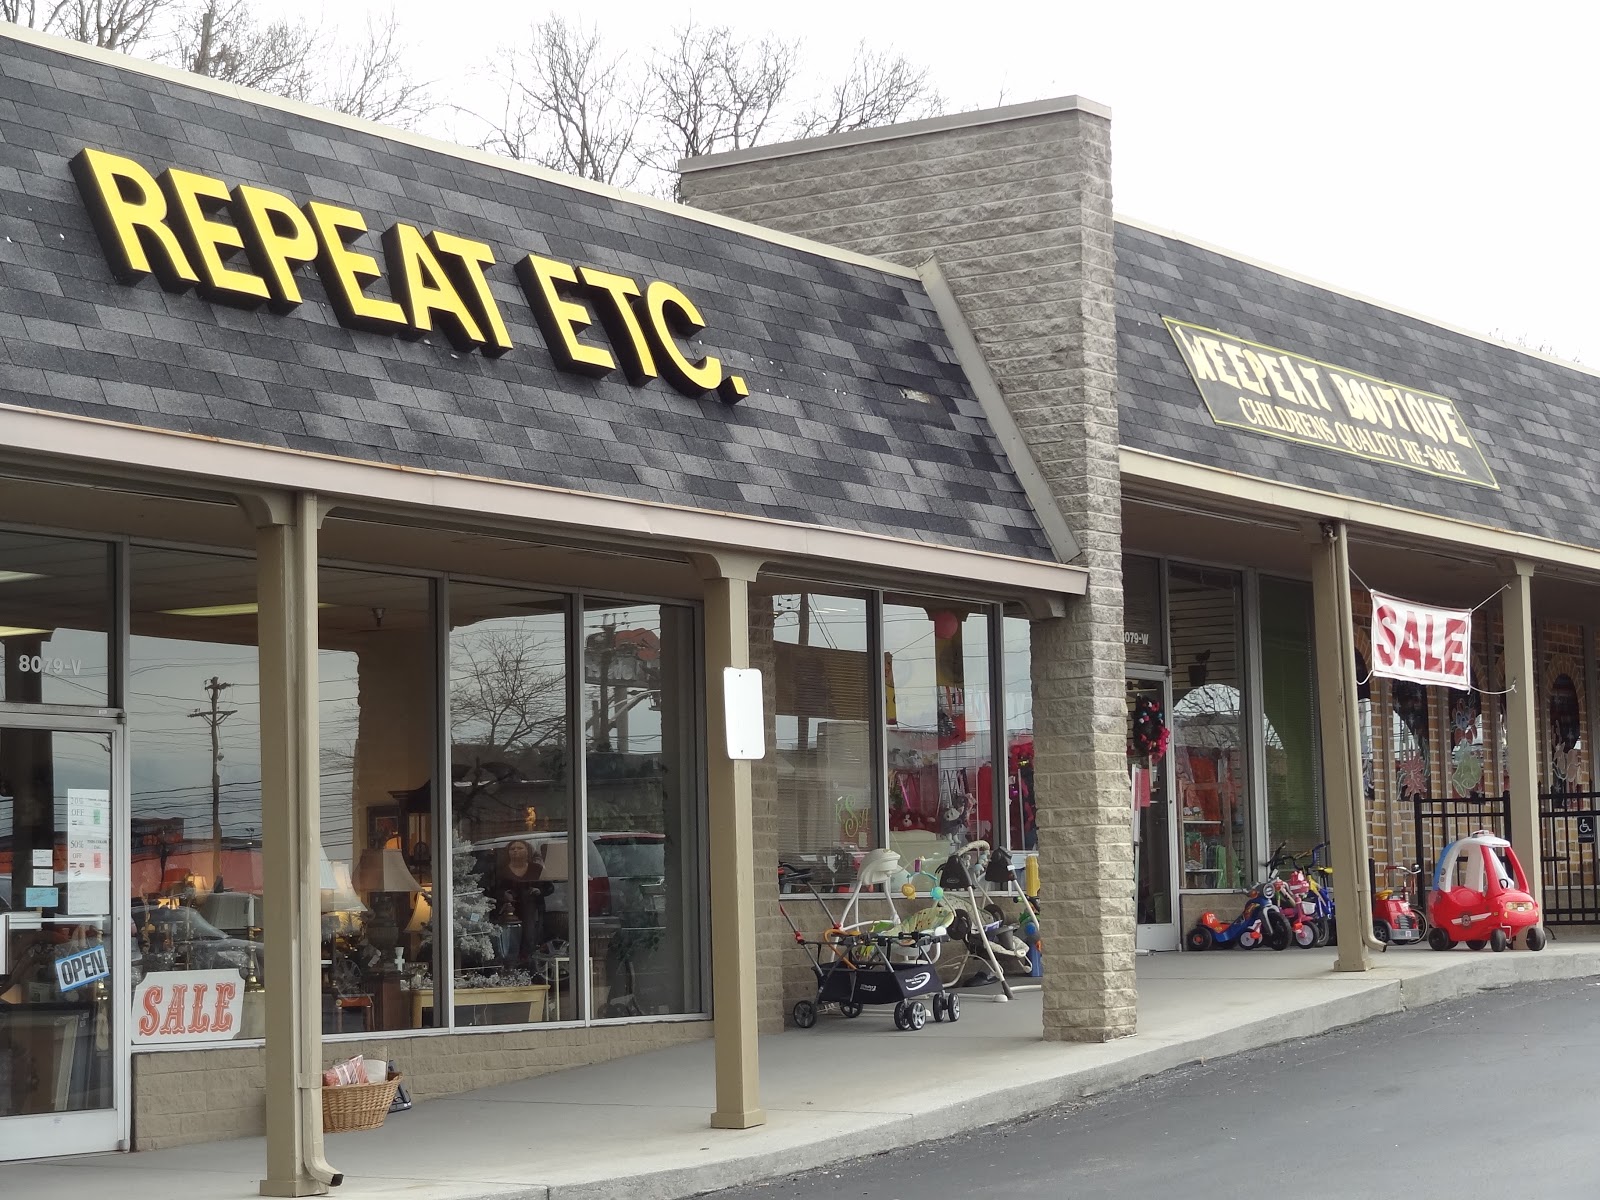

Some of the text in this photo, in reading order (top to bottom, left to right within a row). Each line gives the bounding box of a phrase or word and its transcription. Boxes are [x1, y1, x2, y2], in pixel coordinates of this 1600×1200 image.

[75, 147, 749, 396] REPEAT ETC.
[1174, 325, 1473, 449] WEEPEAT BOUTIQUE
[1238, 396, 1468, 476] CHILDRENS QUALITY RE-SALE
[18, 654, 82, 676] 8079-V
[1123, 631, 1149, 645] 079-W
[1375, 604, 1467, 677] SALE
[60, 950, 106, 986] OPEN
[138, 982, 237, 1037] SALE
